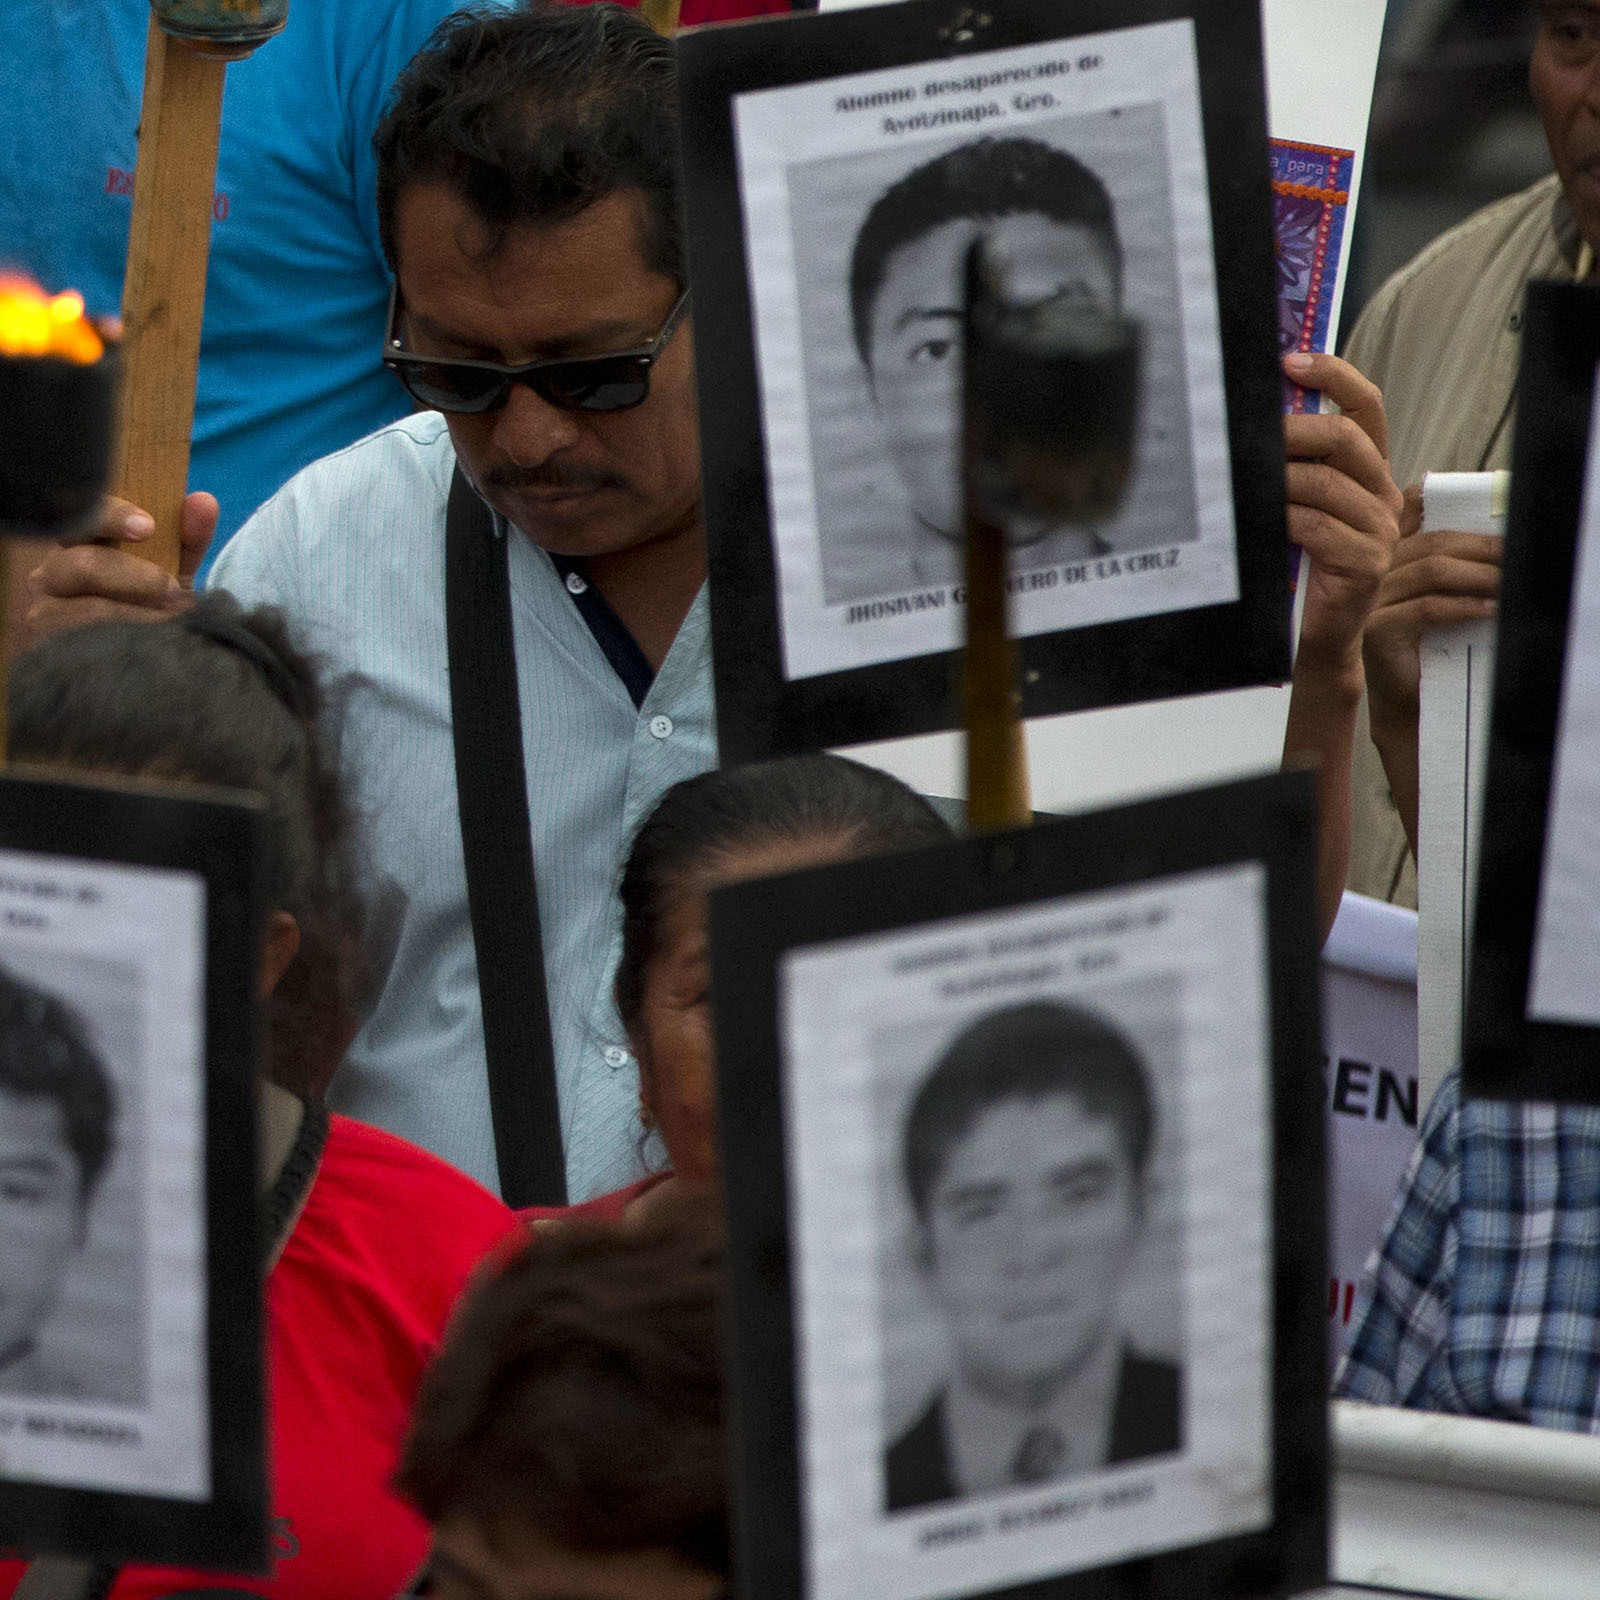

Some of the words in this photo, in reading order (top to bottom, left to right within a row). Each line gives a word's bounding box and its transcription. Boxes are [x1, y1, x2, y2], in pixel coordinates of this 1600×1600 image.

[835, 86, 917, 113] Alumno
[923, 58, 1072, 98] desaparecido
[1077, 53, 1104, 73] de
[1287, 159, 1325, 175] para
[1064, 564, 1089, 586] DE
[1095, 557, 1122, 581] LA
[1125, 547, 1182, 573] CRUZ
